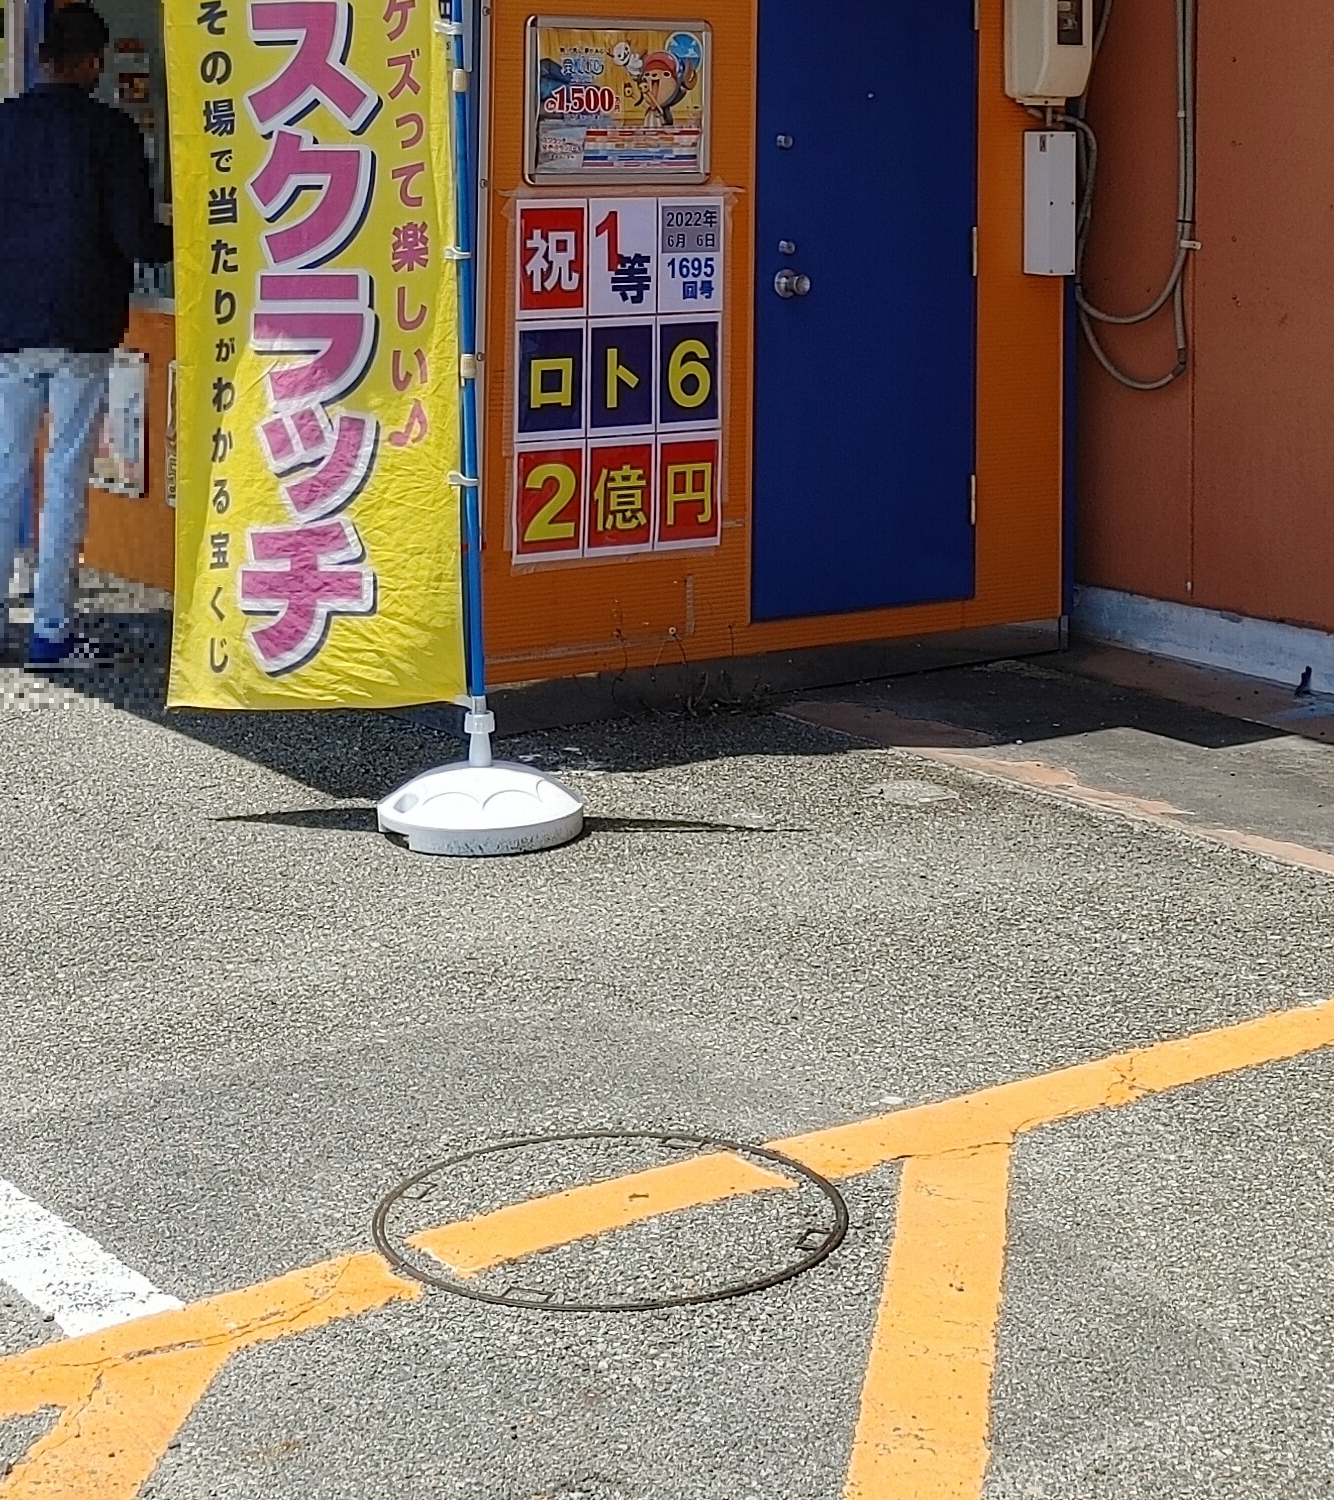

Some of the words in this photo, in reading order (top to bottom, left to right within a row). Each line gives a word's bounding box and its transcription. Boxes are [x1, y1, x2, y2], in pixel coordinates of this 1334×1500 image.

[553, 85, 616, 114] 1,500
[666, 209, 718, 228] 2022年
[667, 233, 686, 248] 6月
[696, 233, 715, 248] 6日
[524, 228, 579, 293] 祝
[667, 257, 715, 279] 1695
[682, 280, 715, 300] 回号
[197, 0, 240, 673] その場で当たりがわかる宝くじ
[241, 0, 373, 668] スクラッチ
[529, 339, 712, 410] ロト6
[523, 462, 713, 543] 2億円
